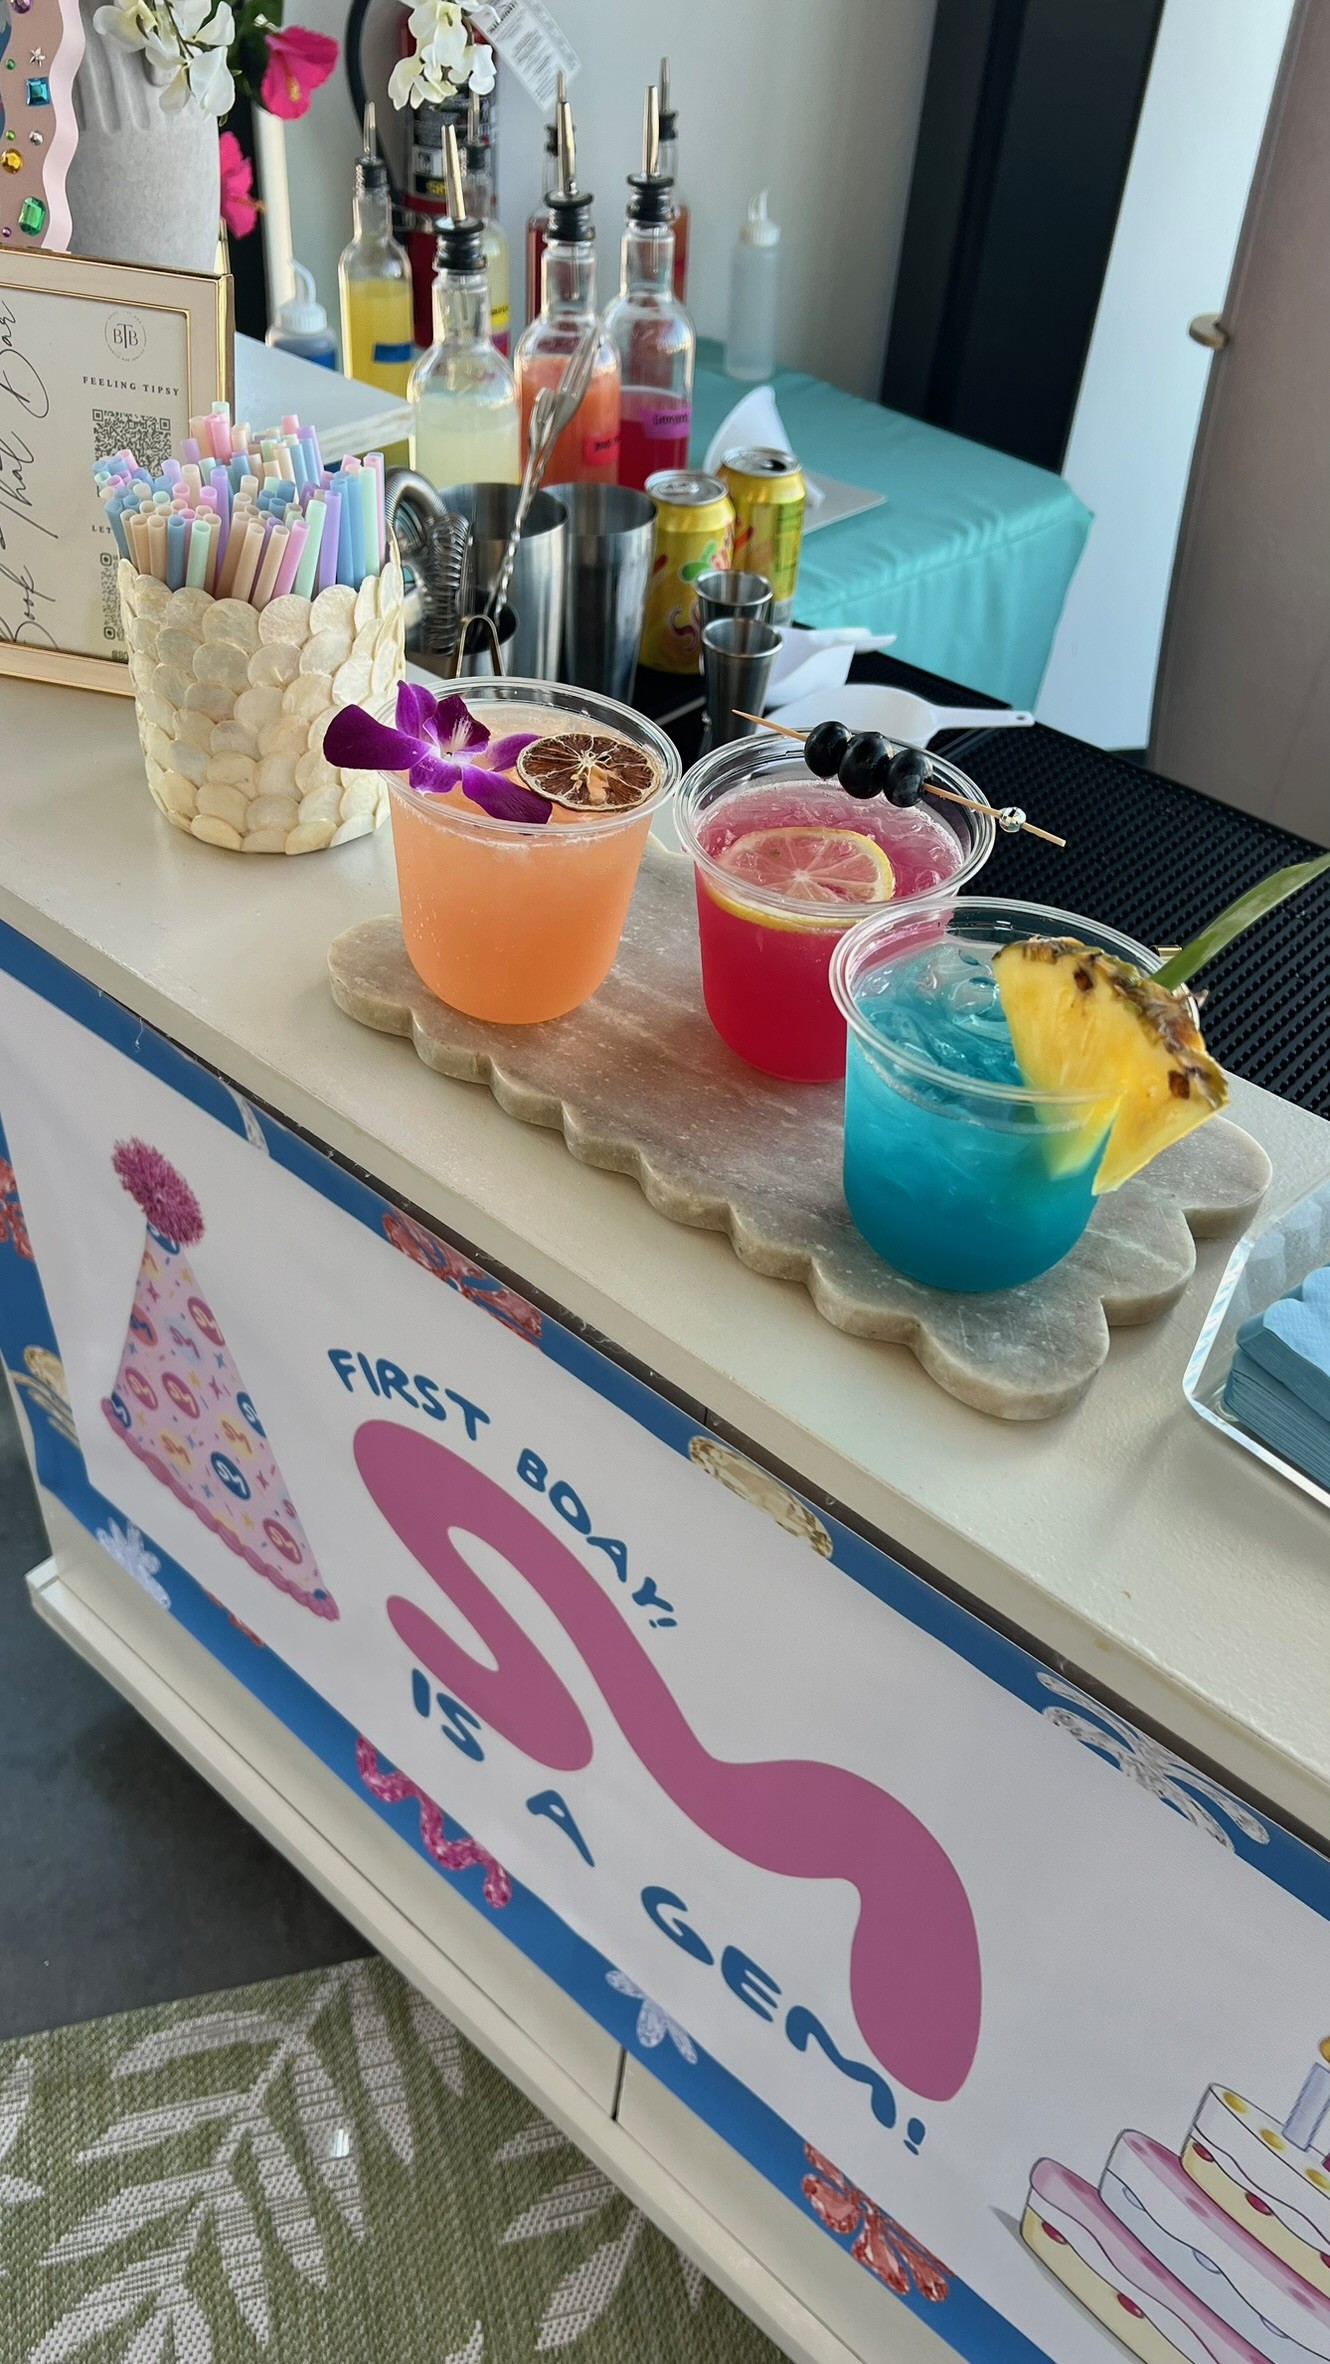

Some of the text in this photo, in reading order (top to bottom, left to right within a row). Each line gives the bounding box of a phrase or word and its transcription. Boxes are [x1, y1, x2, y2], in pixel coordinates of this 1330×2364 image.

[82, 376, 180, 397] FEELING TIPSY
[328, 1349, 490, 1441] FIRST
[412, 1668, 926, 2156] IS A GEM!
